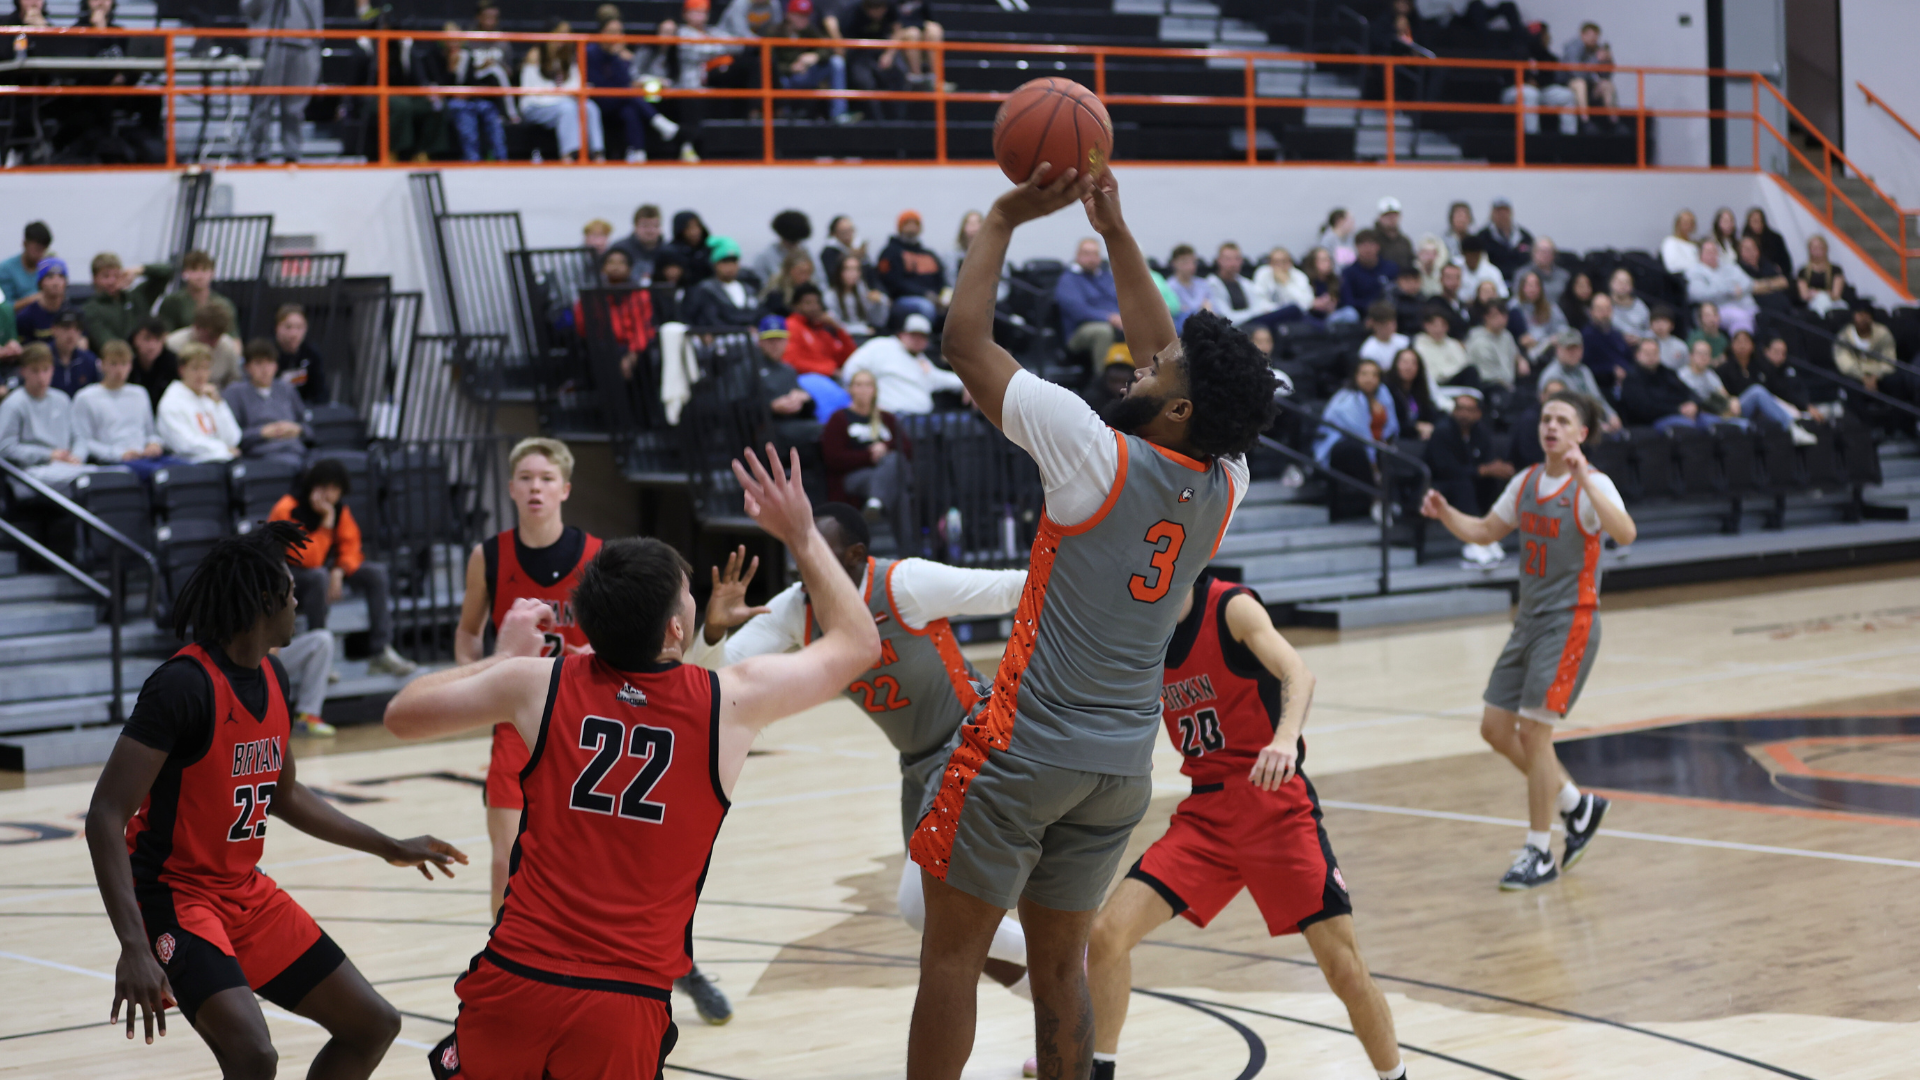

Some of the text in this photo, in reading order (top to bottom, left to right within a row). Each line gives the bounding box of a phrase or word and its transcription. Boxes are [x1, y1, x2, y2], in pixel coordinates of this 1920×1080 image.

[1127, 519, 1187, 604] 3
[1525, 540, 1547, 578] 21
[849, 675, 911, 713] 22
[231, 735, 283, 778] BRYAN
[1178, 706, 1226, 757] 20
[569, 714, 675, 825] 22
[226, 781, 277, 842] 23
